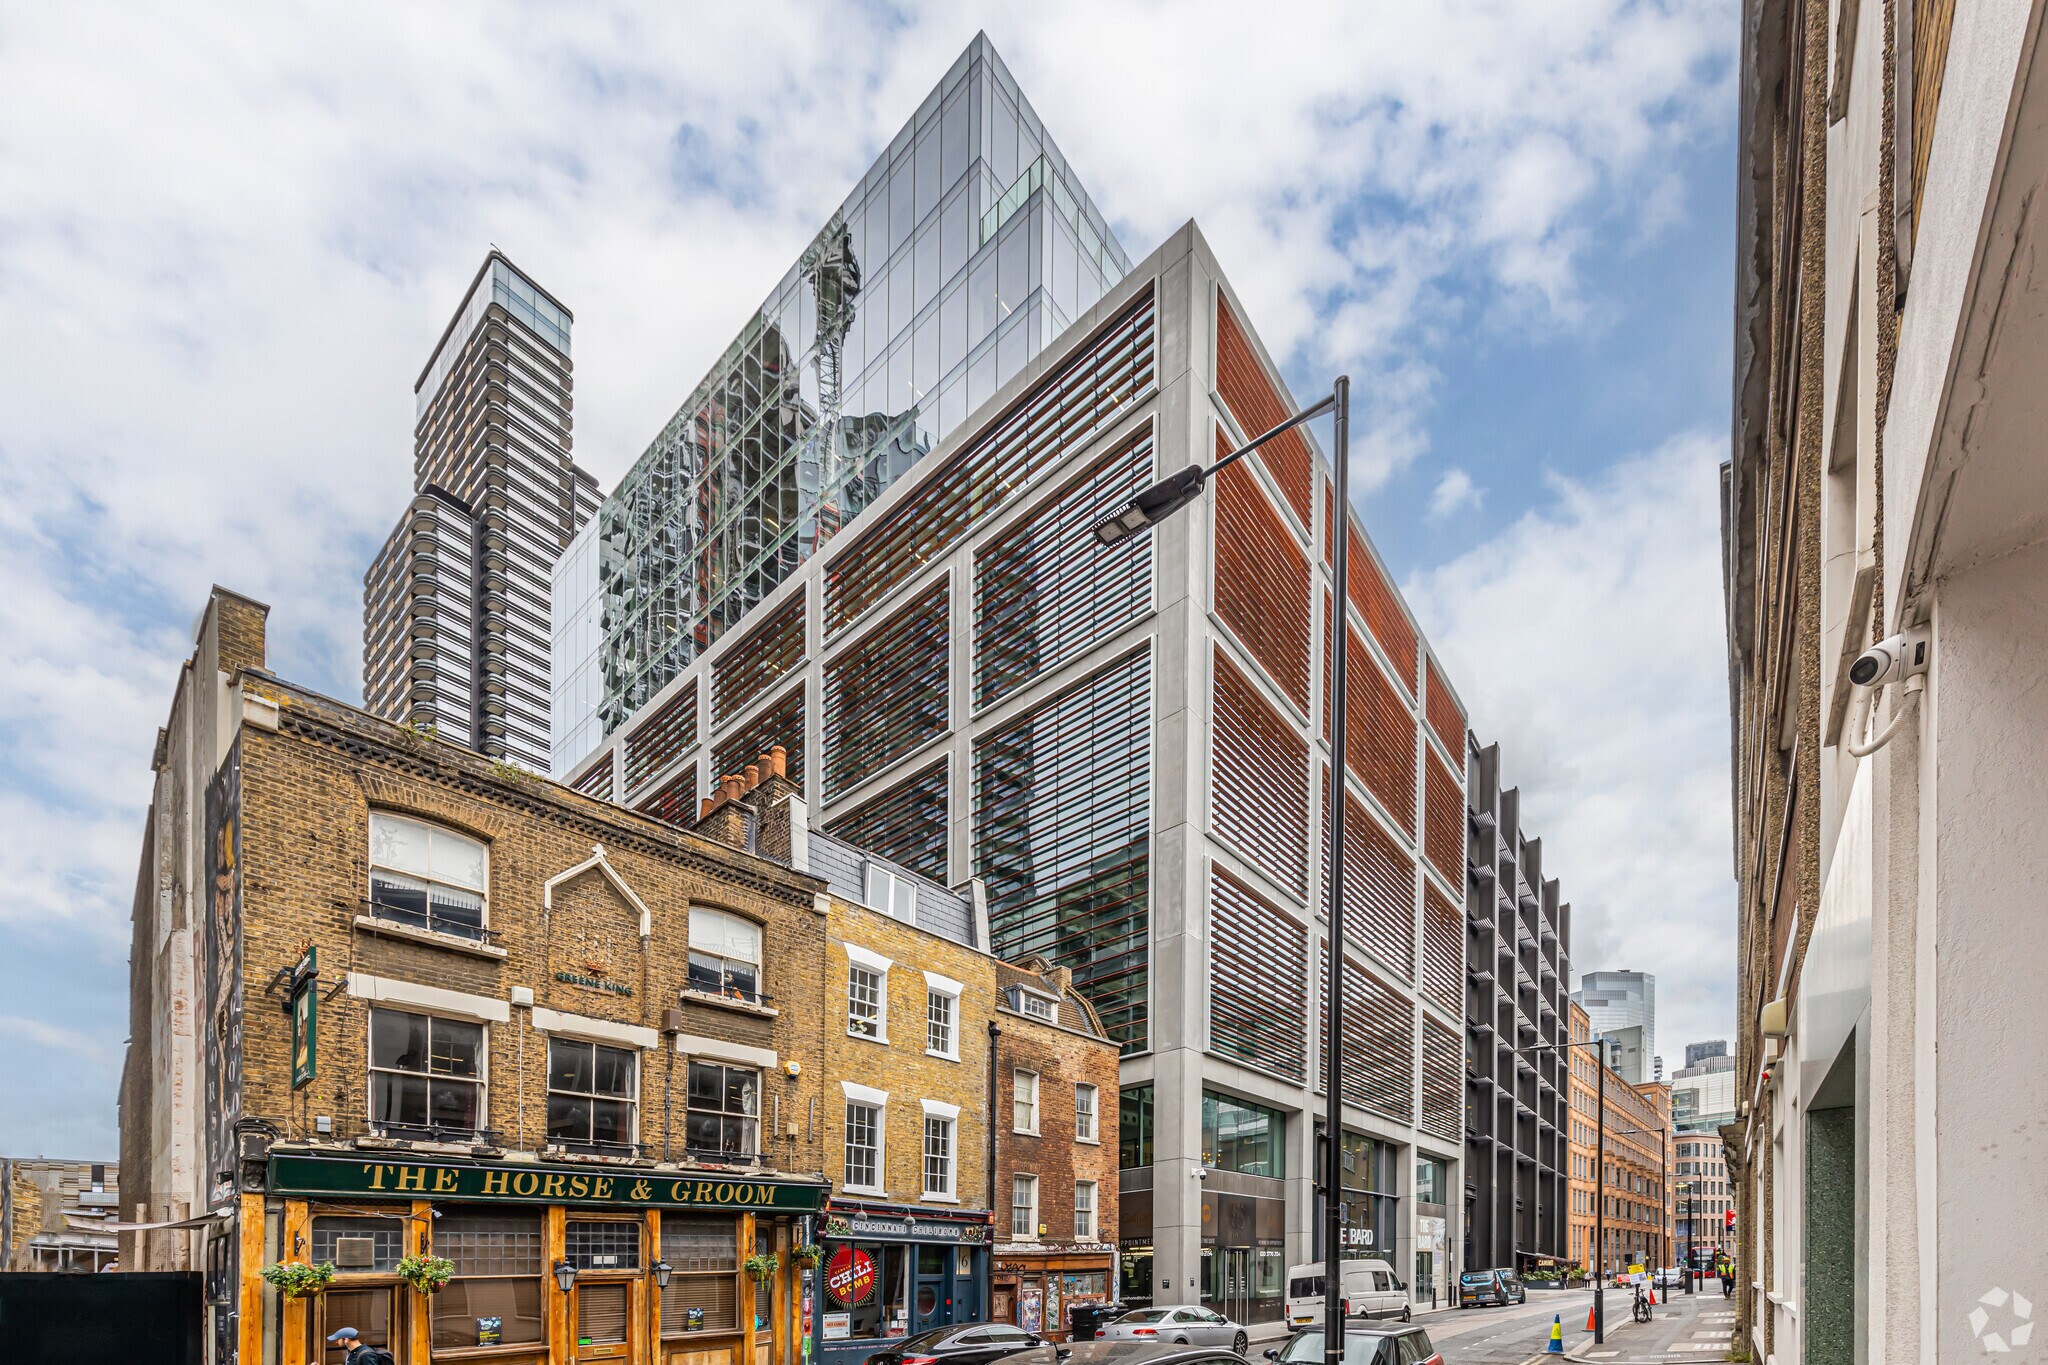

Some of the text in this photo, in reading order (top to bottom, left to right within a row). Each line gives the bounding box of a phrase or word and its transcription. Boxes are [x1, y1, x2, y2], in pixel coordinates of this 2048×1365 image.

[555, 972, 634, 998] GREENE KING
[363, 1164, 777, 1205] THE HORSE & GROOM
[853, 1222, 960, 1236] CINCINNATI CHILIBOMB
[1349, 1228, 1374, 1245] BARD
[961, 1255, 968, 1268] 6
[830, 1261, 872, 1289] CHILI
[839, 1275, 870, 1296] BOMB
